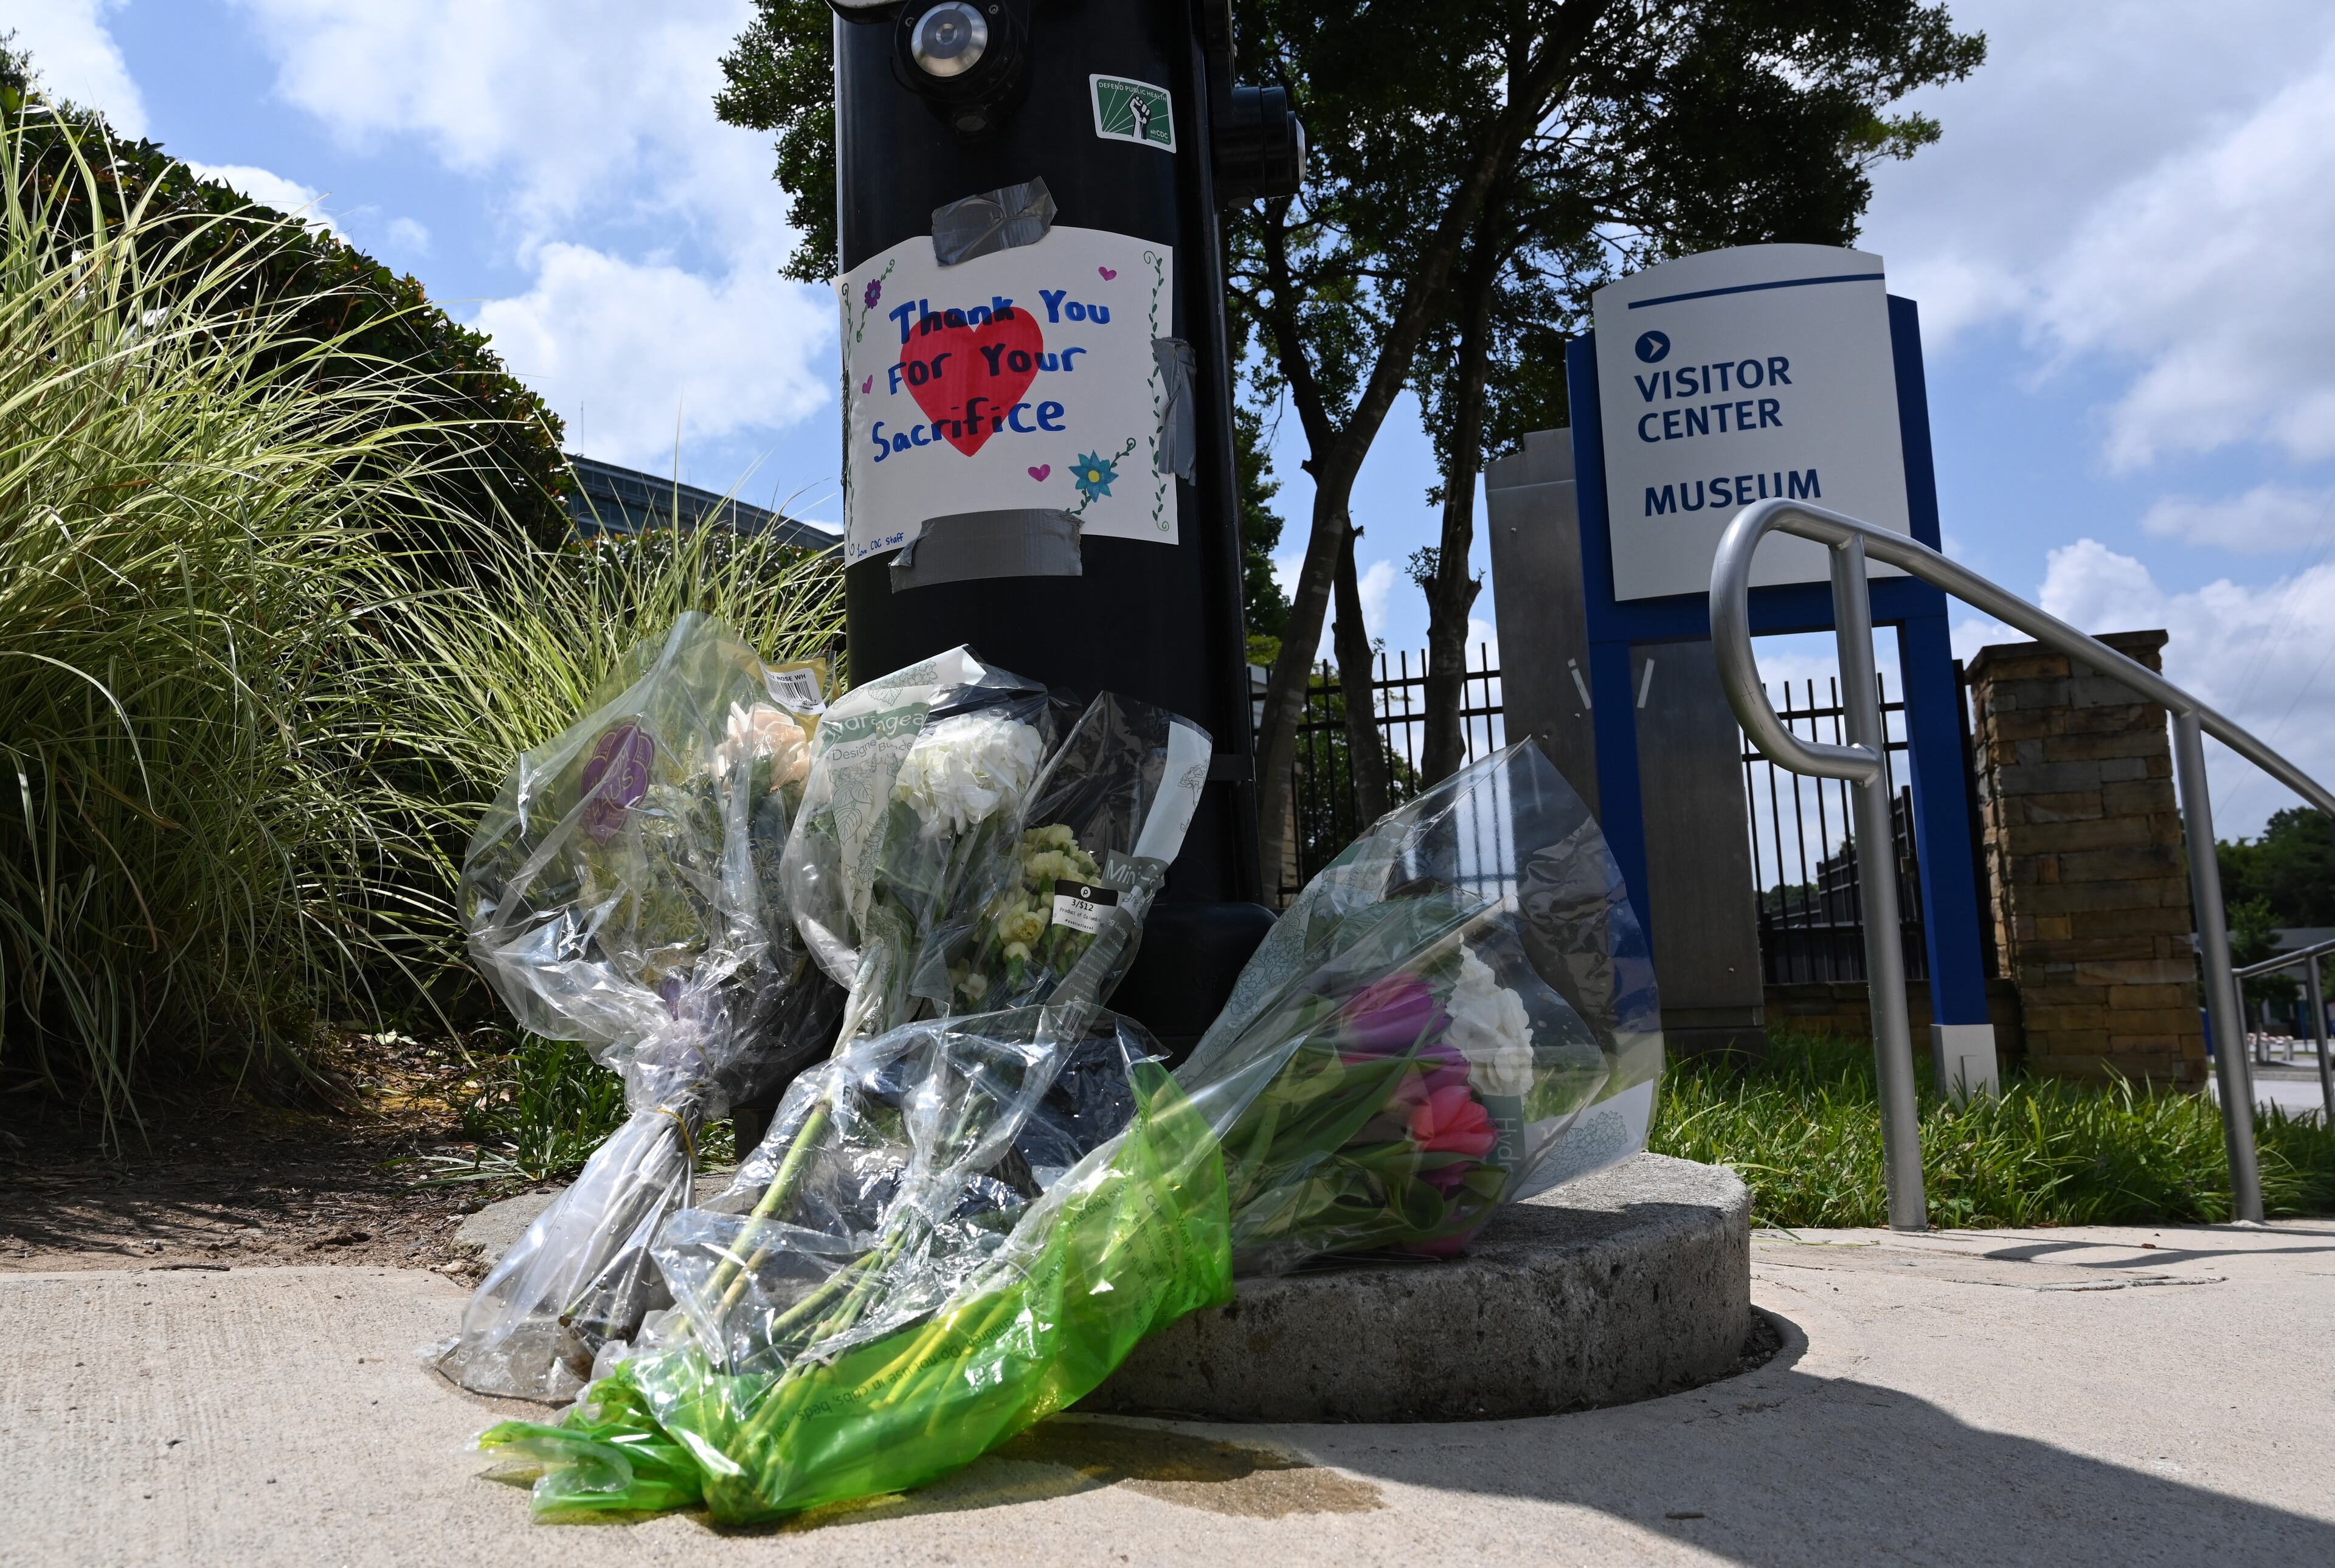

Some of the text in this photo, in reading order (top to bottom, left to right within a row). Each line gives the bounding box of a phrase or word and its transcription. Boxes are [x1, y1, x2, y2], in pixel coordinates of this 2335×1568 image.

[1098, 81, 1167, 102] DEFEND PUBLIC HEALTH
[889, 289, 1111, 345] Thank You
[980, 342, 1087, 377] Your
[1634, 356, 1793, 402] VISITOR
[871, 397, 1067, 463] Sacrifice
[1638, 398, 1783, 443] CENTER
[1645, 469, 1821, 517] MUSEUM
[870, 538, 882, 550] CDC
[832, 739, 876, 761] Designe
[1059, 907, 1076, 916] Product
[1071, 899, 1094, 912] 3/$12
[1085, 1197, 1110, 1215] bag
[1176, 1214, 1193, 1251] Wash
[941, 1344, 962, 1359] Do
[914, 1355, 938, 1372] not
[871, 1378, 885, 1390] in
